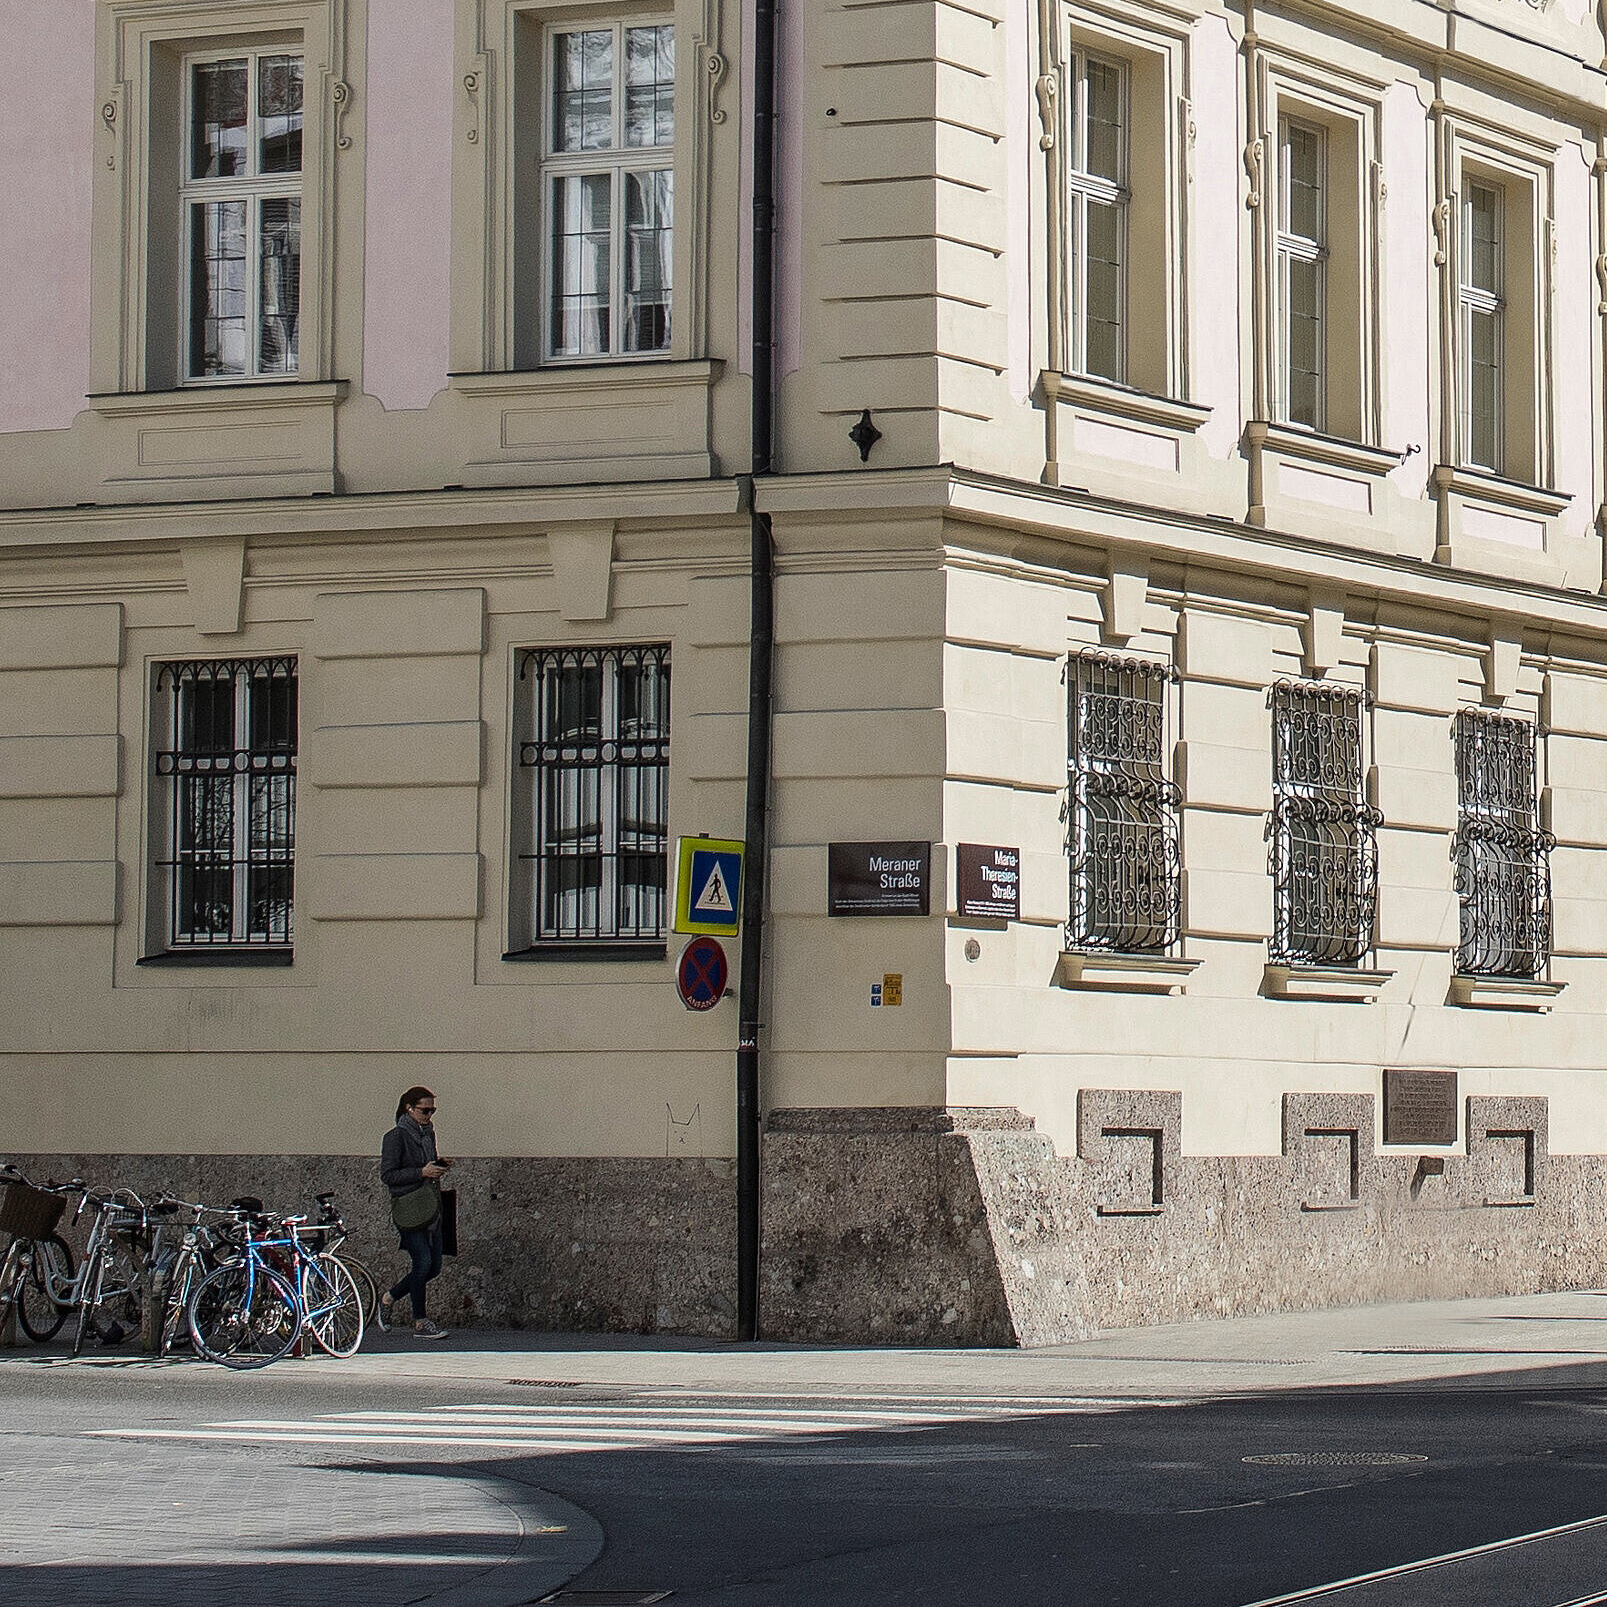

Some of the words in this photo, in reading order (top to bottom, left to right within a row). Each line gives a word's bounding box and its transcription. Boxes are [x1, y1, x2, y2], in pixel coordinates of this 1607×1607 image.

[869, 856, 922, 872] Meraner
[994, 849, 1018, 867] Maria-
[879, 873, 921, 889] Straße
[980, 865, 1018, 883] Theresien-
[991, 883, 1017, 900] Straße
